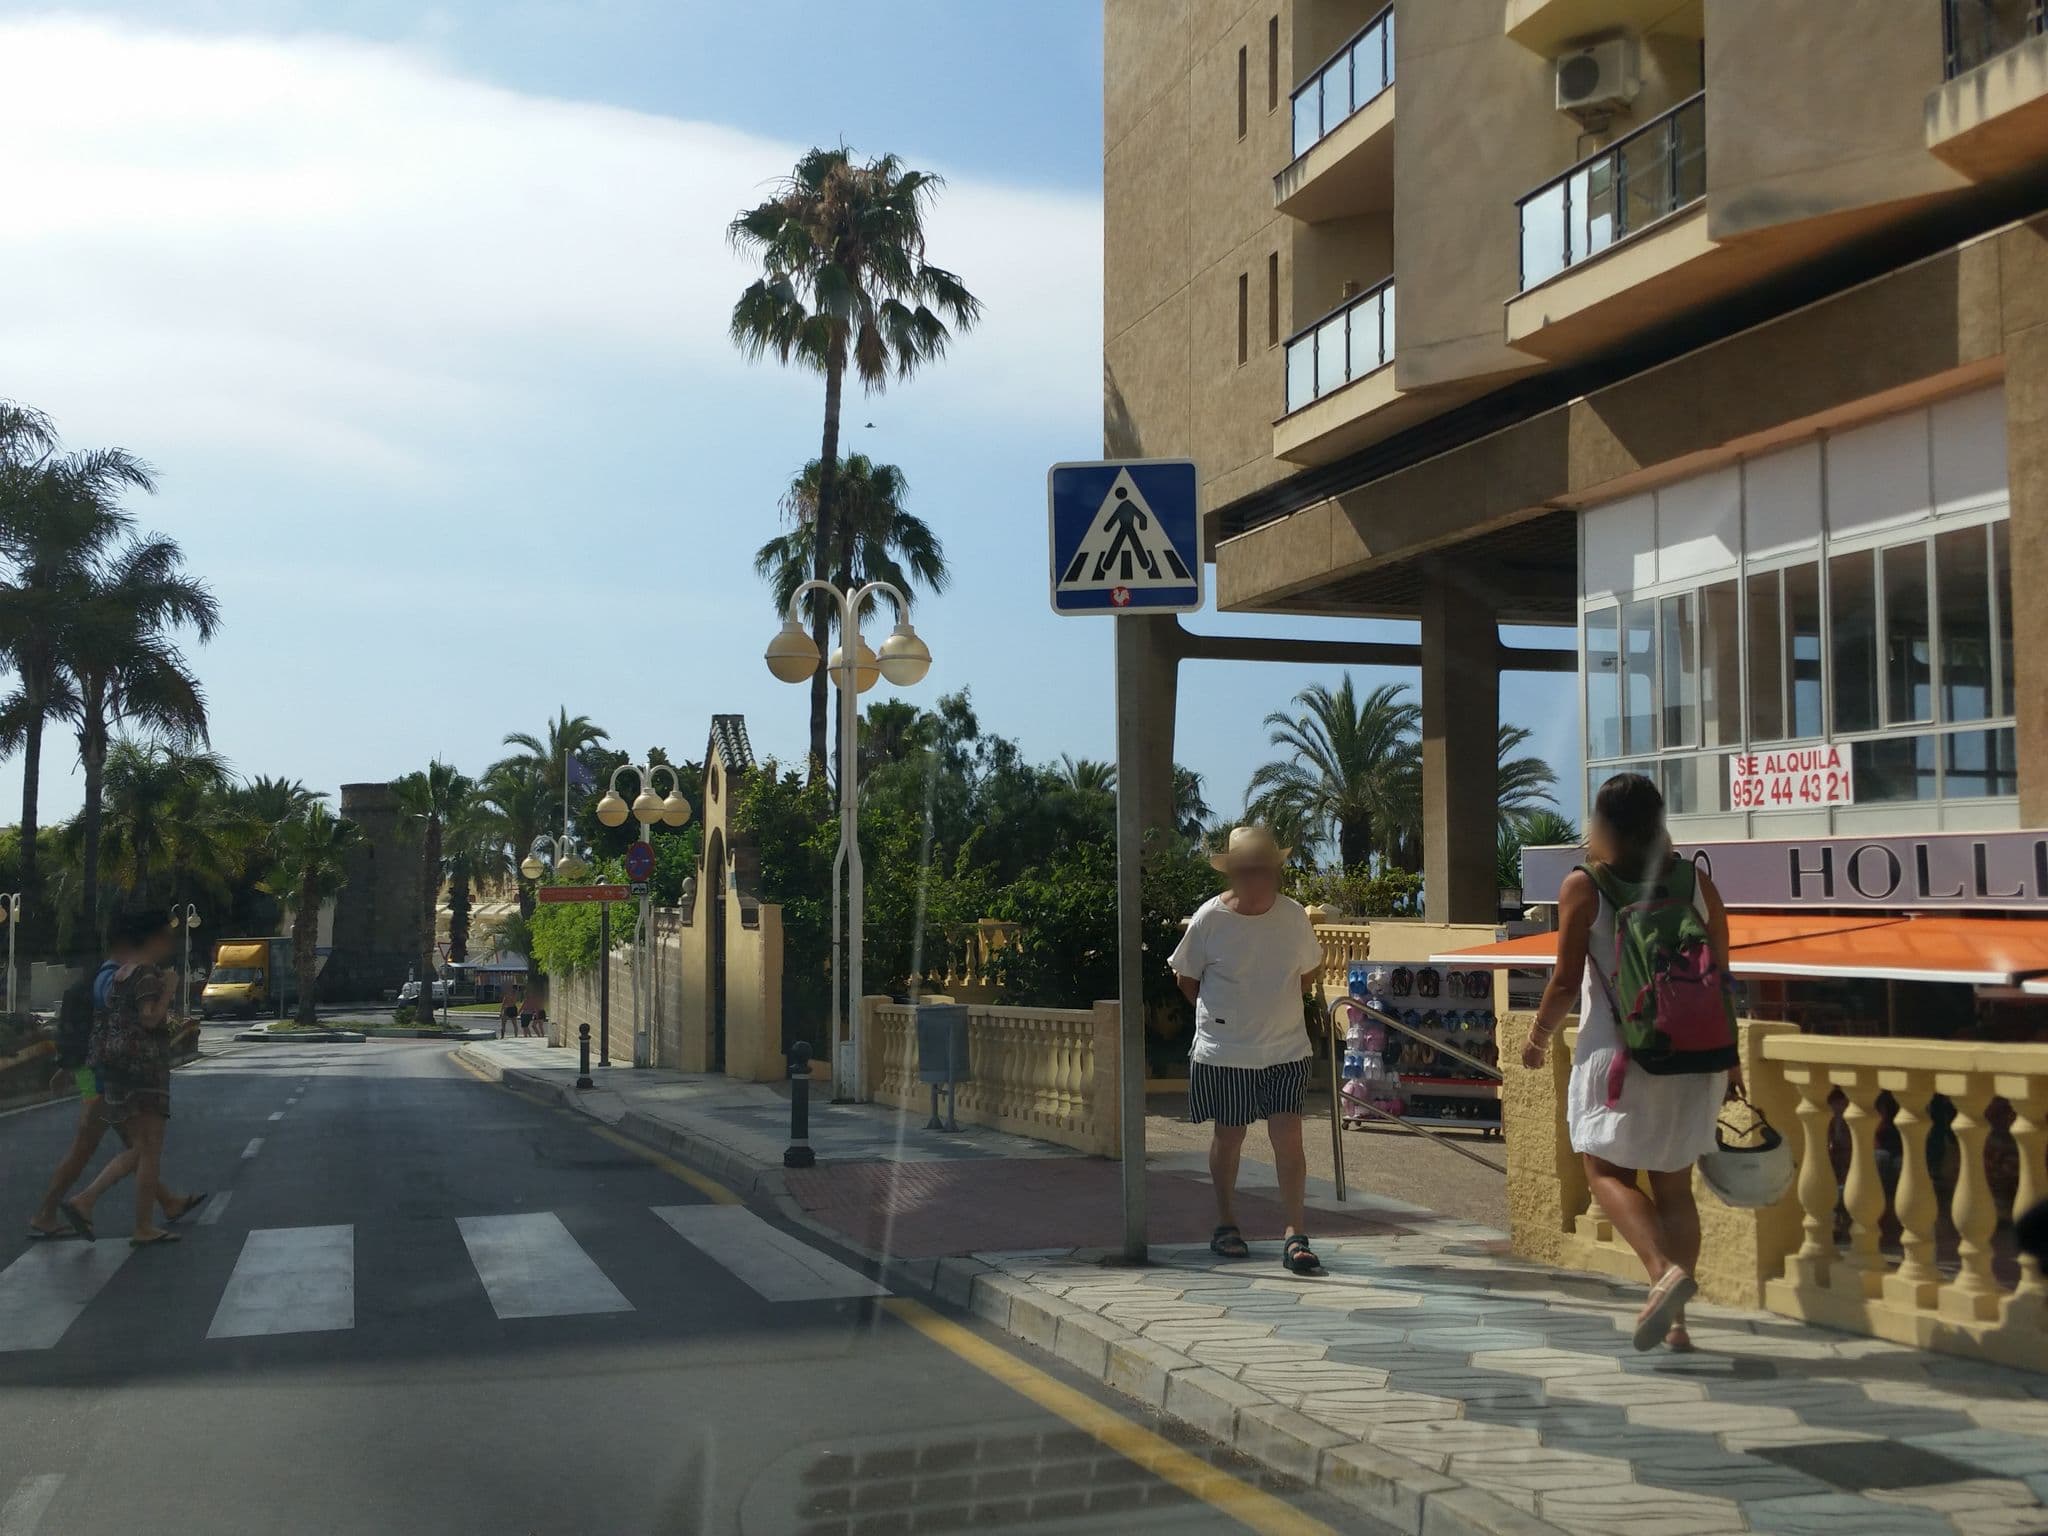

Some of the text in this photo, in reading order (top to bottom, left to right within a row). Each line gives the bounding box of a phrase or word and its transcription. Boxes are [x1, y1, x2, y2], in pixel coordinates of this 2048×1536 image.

[1737, 748, 1841, 777] SE ALQUILA
[1732, 771, 1851, 808] 952 44 43 21
